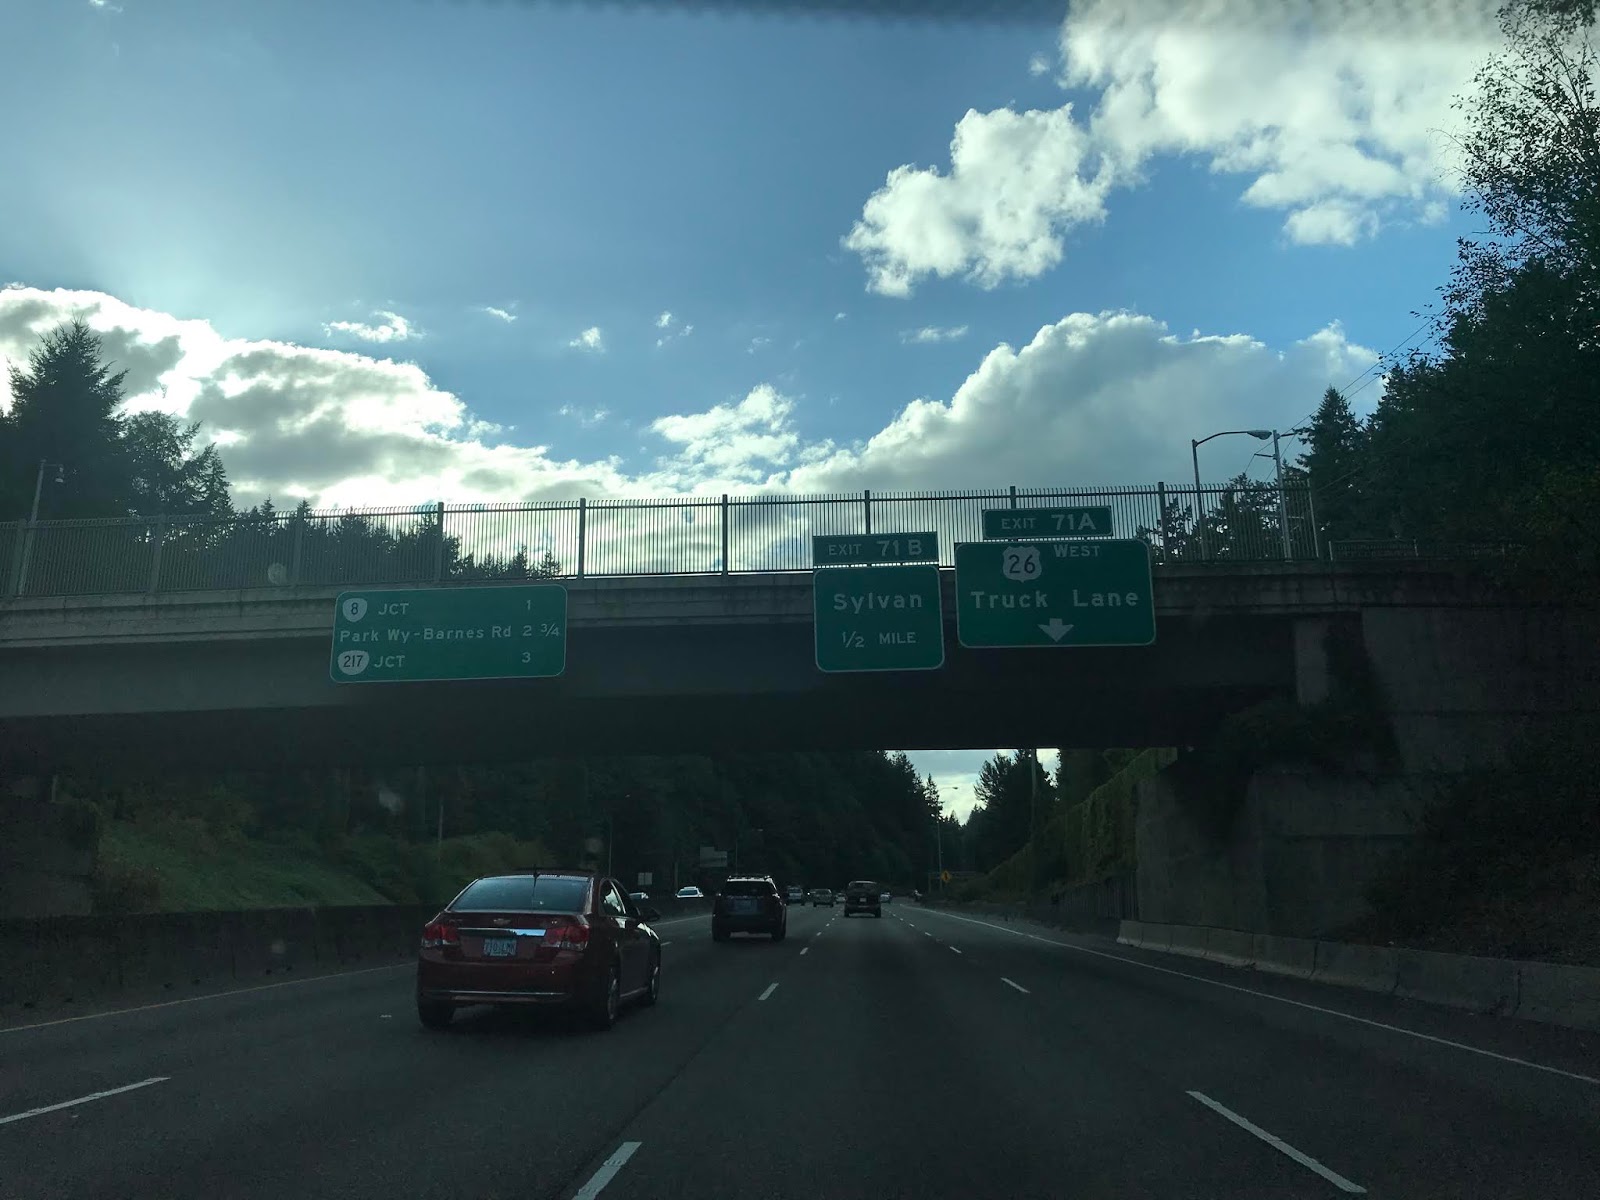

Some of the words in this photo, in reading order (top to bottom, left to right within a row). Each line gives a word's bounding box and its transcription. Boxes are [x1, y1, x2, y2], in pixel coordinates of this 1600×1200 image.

[1001, 518, 1037, 530] EXIT
[1051, 513, 1097, 531] 71A
[828, 544, 862, 557] EXIT
[1053, 544, 1101, 558] WEST
[1008, 554, 1036, 574] 26
[350, 602, 359, 615] 8
[378, 603, 409, 615] JCT
[526, 599, 532, 611] 1
[833, 592, 922, 614] Sylvan
[971, 591, 1049, 609] Truck
[1072, 590, 1139, 608] Lane
[340, 629, 379, 643] Park
[491, 625, 512, 638] Rd
[522, 624, 532, 637] 2
[879, 632, 917, 645] MILE
[343, 654, 364, 668] 217
[374, 655, 405, 668] JCT
[521, 652, 531, 664] 3
